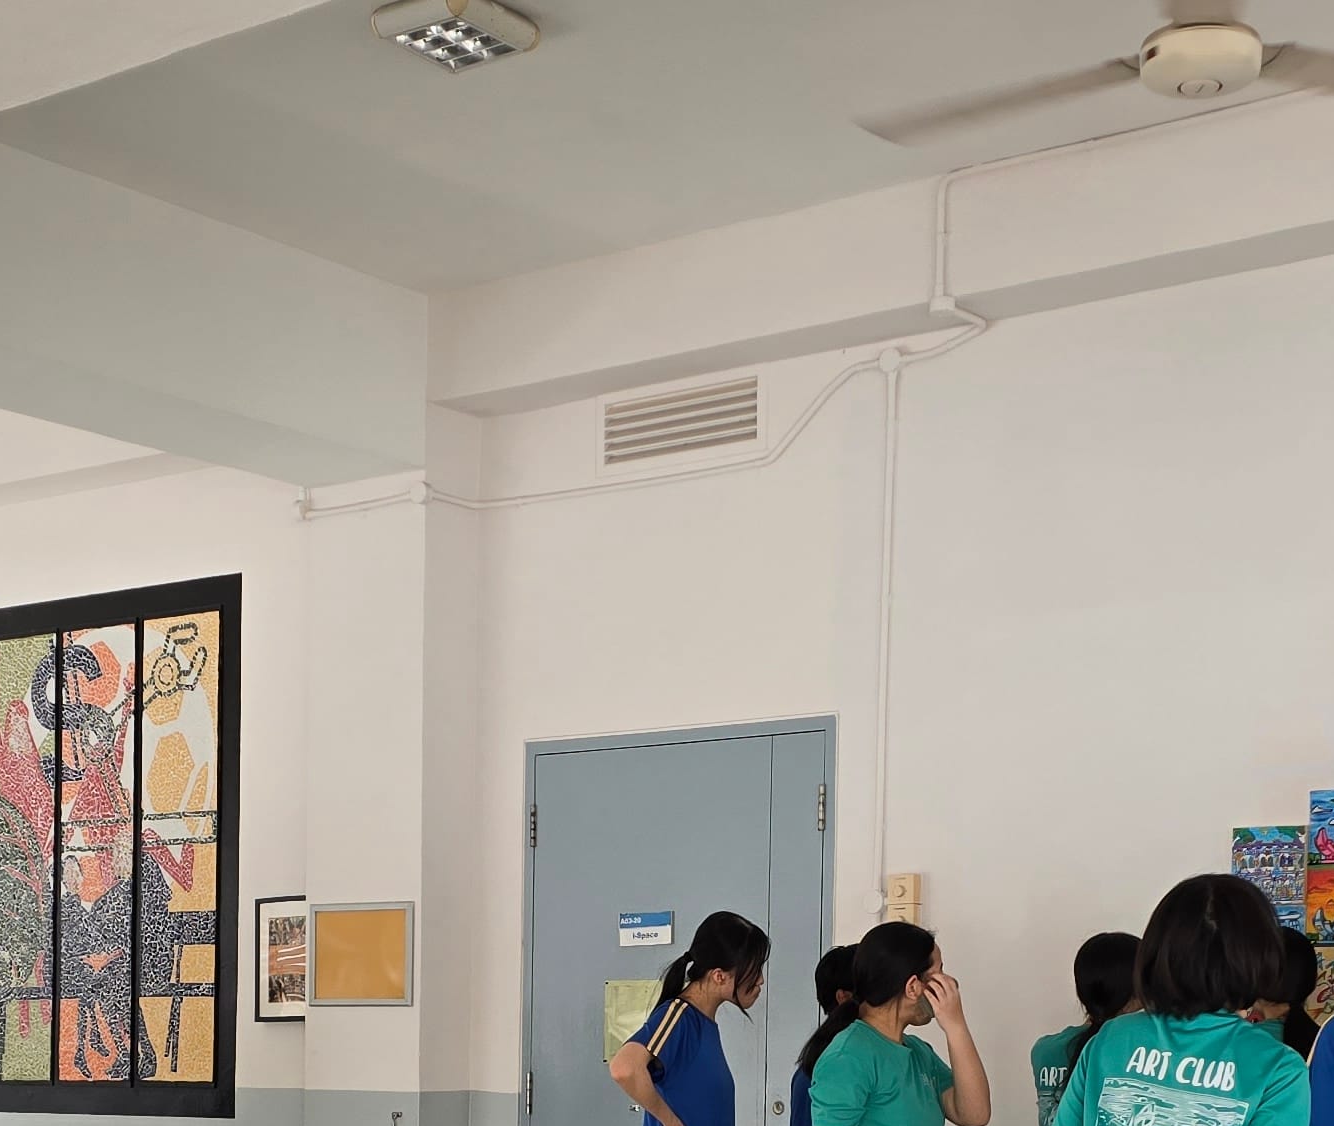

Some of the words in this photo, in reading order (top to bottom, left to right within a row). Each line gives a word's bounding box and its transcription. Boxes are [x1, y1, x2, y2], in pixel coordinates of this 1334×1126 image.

[1040, 1066, 1068, 1087] ART
[1126, 1047, 1172, 1082] ART
[1175, 1056, 1237, 1092] CLUB
